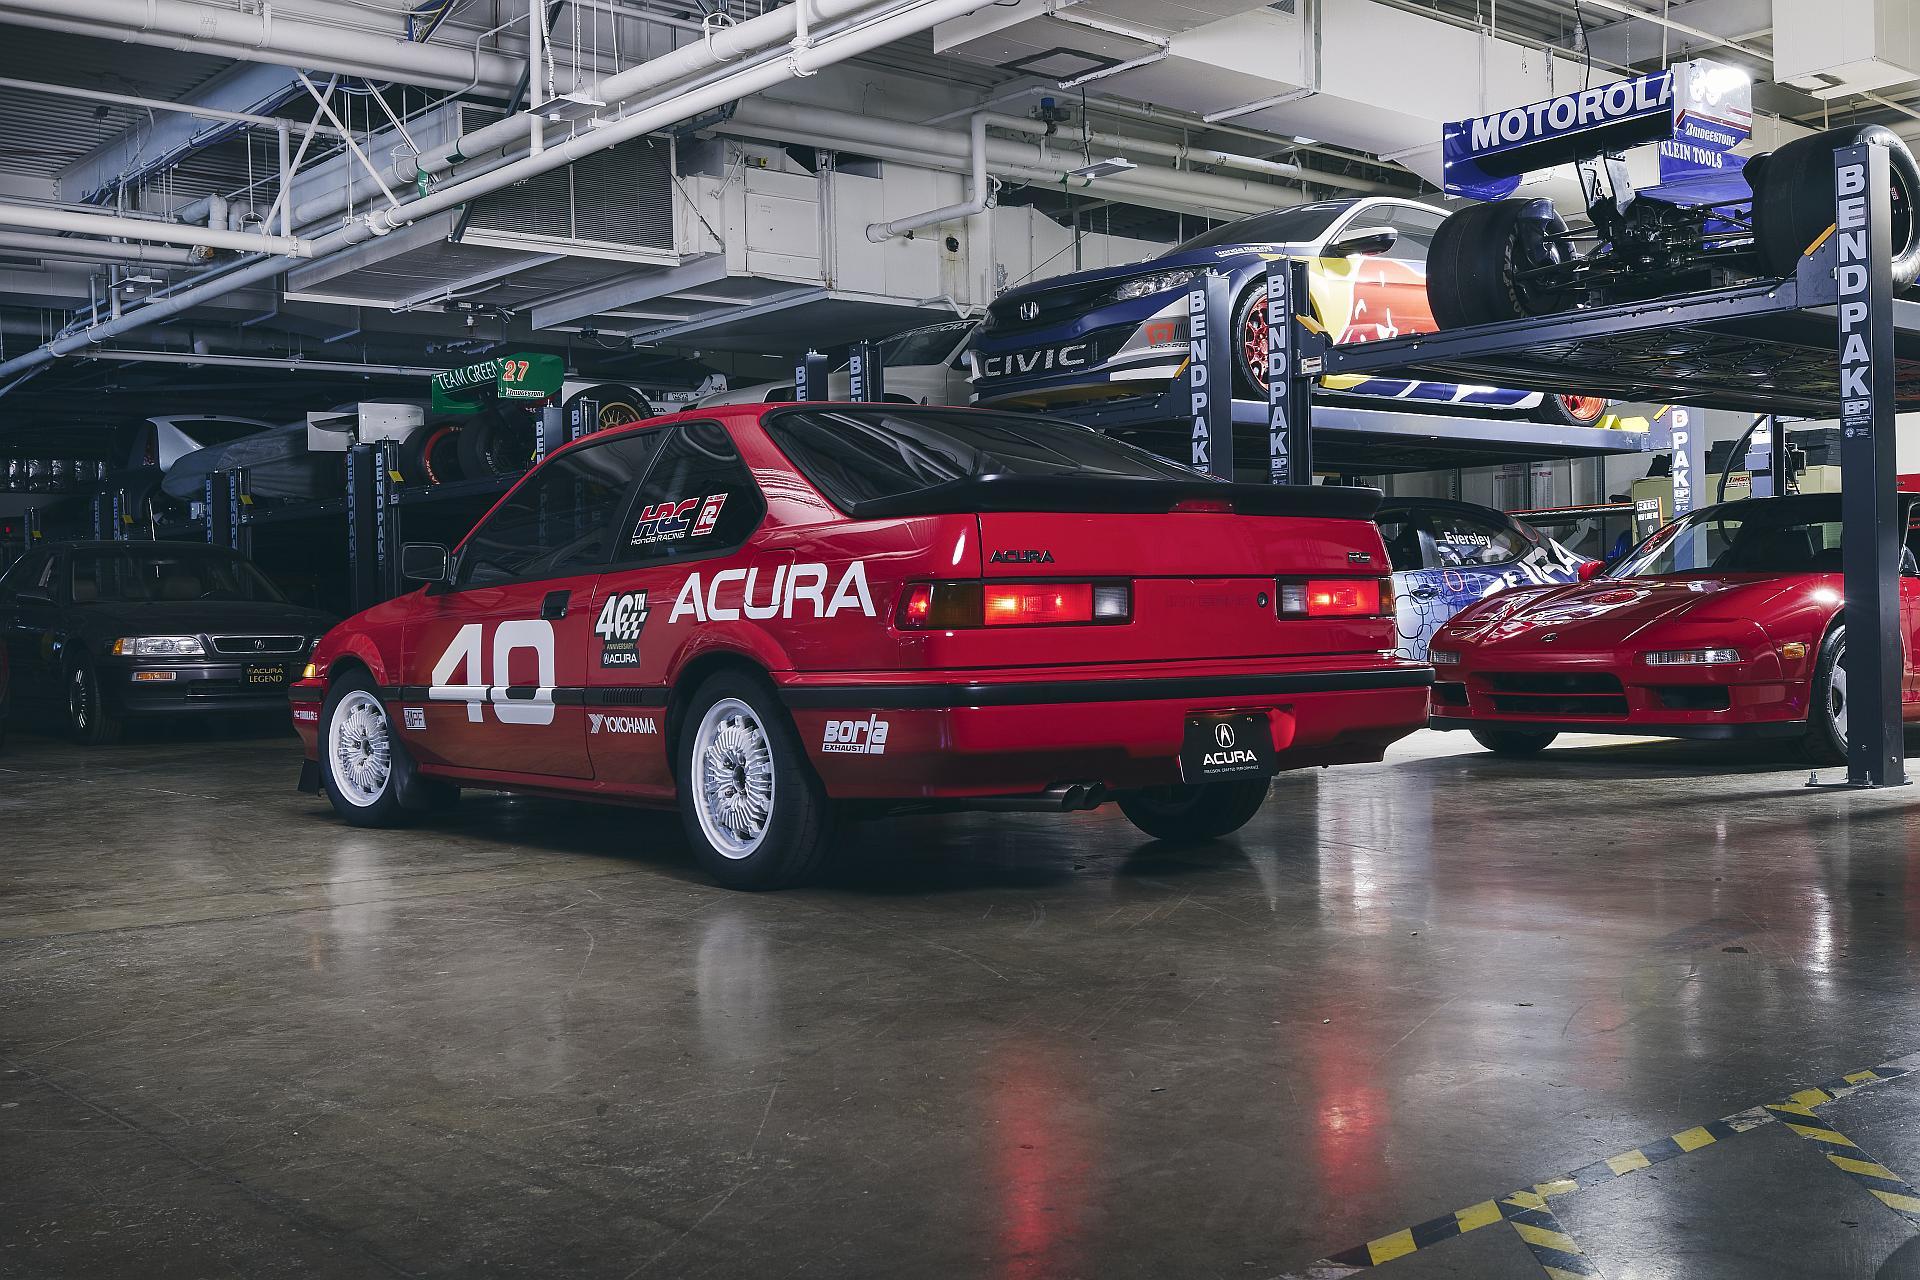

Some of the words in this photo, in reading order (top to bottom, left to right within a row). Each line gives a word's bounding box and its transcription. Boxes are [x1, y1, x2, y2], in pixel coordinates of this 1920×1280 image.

[1471, 70, 1673, 151] MOTOROLA
[1685, 122, 1736, 147] BRIDGESTONE
[1659, 140, 1692, 161] KLEIN
[1693, 147, 1723, 169] TOOLS
[503, 360, 529, 381] 27
[984, 343, 1087, 377] CIVIC
[1267, 274, 1288, 456] BENDPAK
[436, 369, 465, 389] TEAM
[468, 361, 498, 383] GREEN
[1189, 289, 1209, 464] BENDPAK
[1637, 500, 1657, 509] RTR
[1444, 531, 1492, 549] Eversley
[989, 549, 1054, 563] ACURA
[667, 560, 877, 624] ACURA
[606, 642, 635, 650] ANNIVERSARY
[609, 653, 637, 664] ACURA
[249, 675, 283, 683] LEGEND
[428, 619, 558, 725] 40
[604, 717, 658, 734] YOKOHAMA
[824, 744, 863, 752] EXHAUST
[1203, 749, 1258, 766] ACURA
